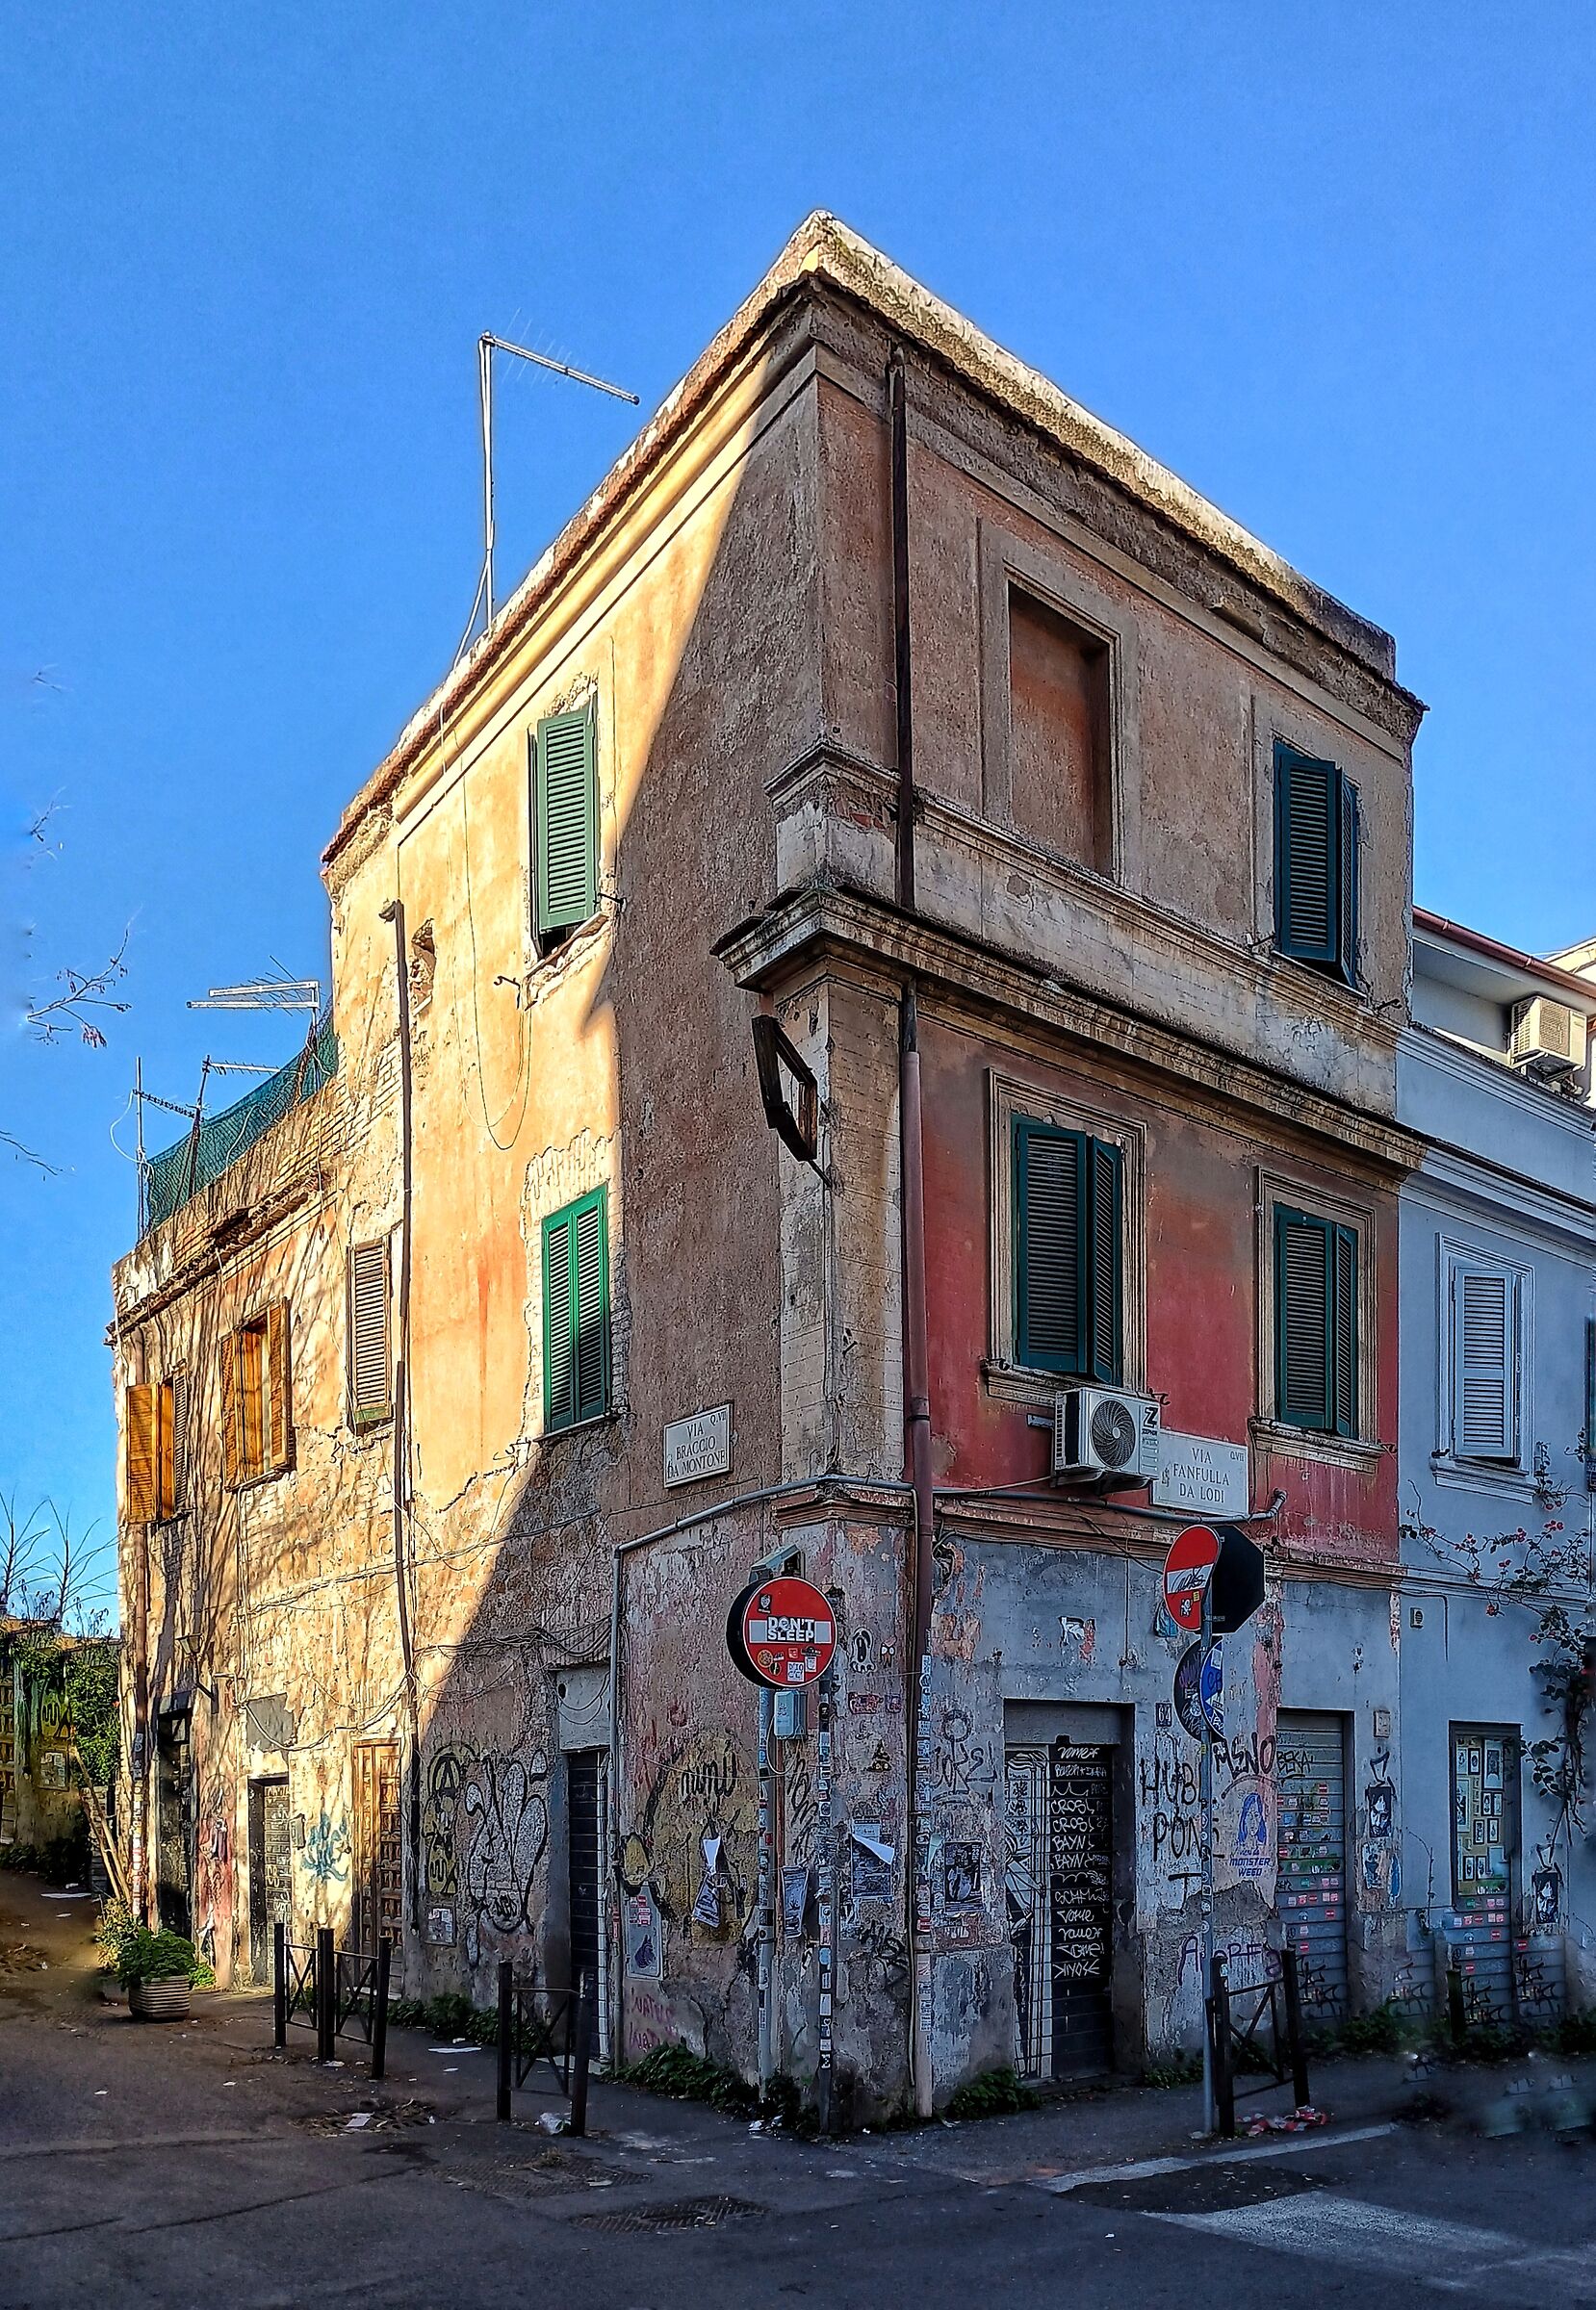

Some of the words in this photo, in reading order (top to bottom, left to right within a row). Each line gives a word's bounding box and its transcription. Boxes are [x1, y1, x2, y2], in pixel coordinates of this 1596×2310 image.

[687, 1422, 704, 1439] VIA
[677, 1436, 715, 1460] BRACCIO
[1192, 1447, 1212, 1464] VIA
[682, 1450, 726, 1475] MONTONE
[1173, 1463, 1230, 1486] FANFULLA
[1179, 1483, 1195, 1499] DA
[1200, 1486, 1224, 1503] LODI
[767, 1617, 814, 1631] DON'T
[767, 1629, 814, 1642] SLEEP
[1158, 1707, 1171, 1723] 64
[1229, 1857, 1271, 1866] MONSTER
[1238, 1867, 1263, 1878] WEED
